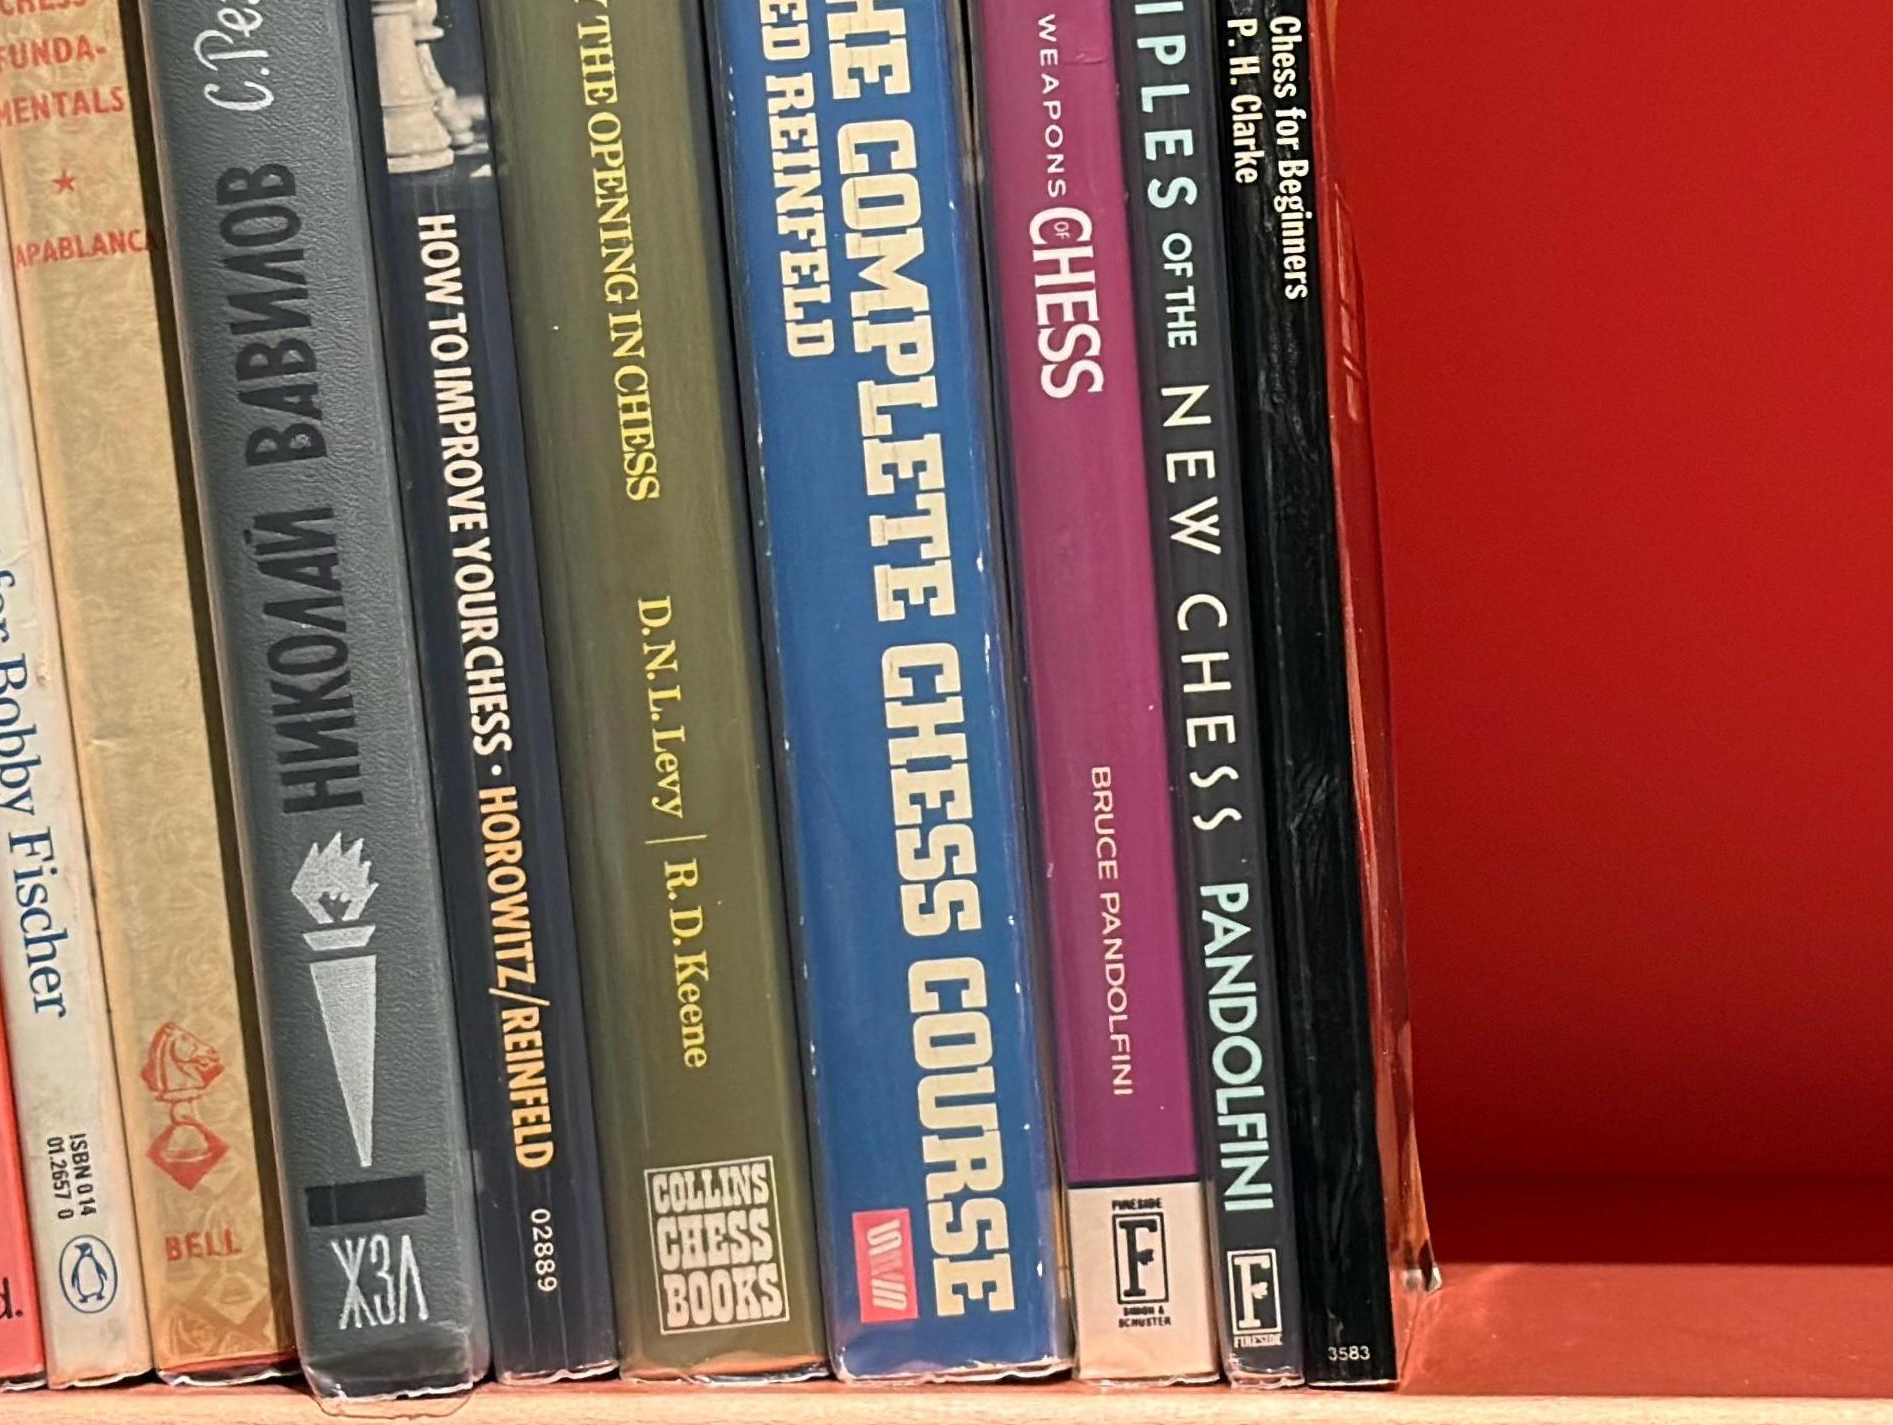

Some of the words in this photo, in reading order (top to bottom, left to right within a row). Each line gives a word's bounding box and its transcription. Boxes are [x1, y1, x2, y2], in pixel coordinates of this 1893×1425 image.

[578, 15, 621, 106] THE
[1227, 18, 1258, 47] P.
[1229, 56, 1261, 86] H.
[1270, 16, 1303, 98] Chess
[1037, 14, 1067, 198] WEAPONS
[1230, 94, 1265, 184] Clarke
[1275, 107, 1307, 151] for
[14, 228, 152, 271] APABLANC
[418, 214, 464, 305] HOW
[587, 112, 639, 304] OPENING
[765, 72, 835, 357] REINFELD
[1053, 221, 1070, 240] OF
[1162, 232, 1194, 277] OF
[1273, 159, 1313, 300] Beginners
[216, 162, 325, 466] ВАВИЛОВ
[427, 313, 469, 361] TO
[609, 310, 645, 360] IN
[1029, 206, 1104, 400] CHESS
[1166, 286, 1198, 348] THE
[837, 118, 956, 622] COMPLETE
[432, 366, 488, 532] IMPROVE
[614, 365, 660, 502] CHESS
[1161, 385, 1222, 555] NEW
[453, 535, 499, 643] YOUR
[244, 508, 364, 815] НИКОЛАЙ
[464, 645, 512, 758] CHESS
[1177, 593, 1242, 831] CHESS
[881, 642, 982, 937] CHESS
[1091, 766, 1119, 880] BRUCE
[9, 827, 68, 1017] Fischer
[478, 786, 555, 1170] HOROWITZ/REINFELD
[674, 949, 709, 1068] Keene
[1100, 892, 1134, 1096] PANDOLFINI
[1200, 883, 1274, 1211] PANDOLFINI
[652, 1163, 769, 1214] COLLINS
[908, 957, 1015, 1317] COURSE
[57, 1208, 75, 1219] 0
[165, 1226, 244, 1262] BELL
[530, 1208, 558, 1292] 02889
[657, 1208, 774, 1271] CHESS
[330, 1234, 430, 1330] ЖЗЛ
[663, 1263, 783, 1329] BOOKS
[1328, 1345, 1371, 1362] 3583
